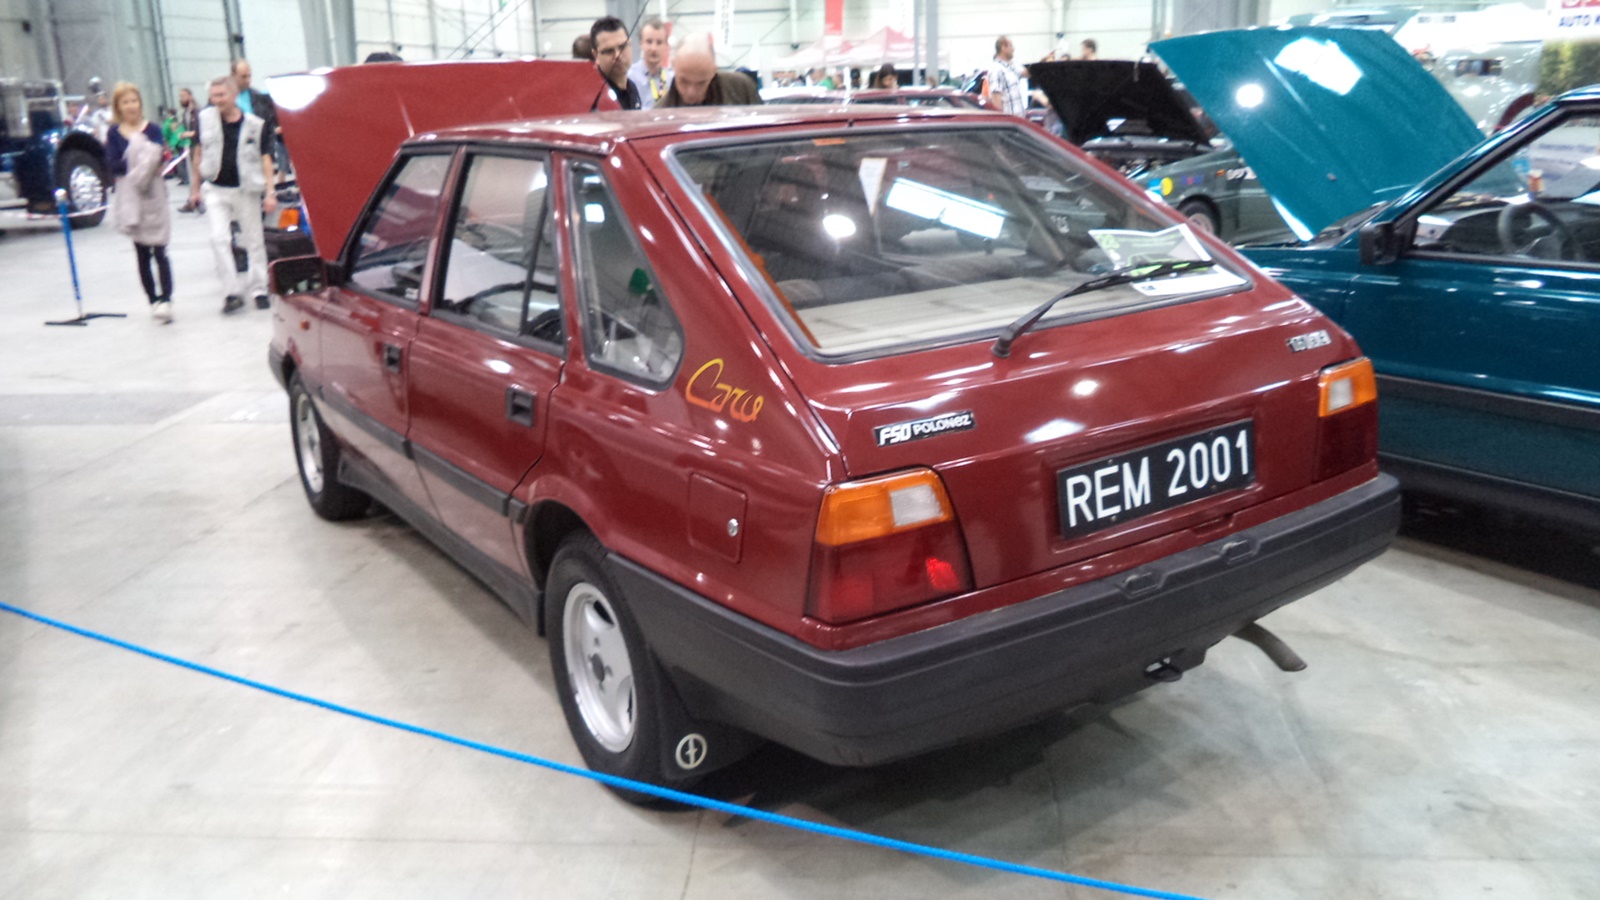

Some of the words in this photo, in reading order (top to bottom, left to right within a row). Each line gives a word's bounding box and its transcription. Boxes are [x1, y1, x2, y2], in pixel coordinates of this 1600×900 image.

[1559, 14, 1592, 27] AUTO
[879, 423, 912, 446] FSO
[1066, 456, 1151, 528] REM
[1166, 429, 1249, 498] 2001
